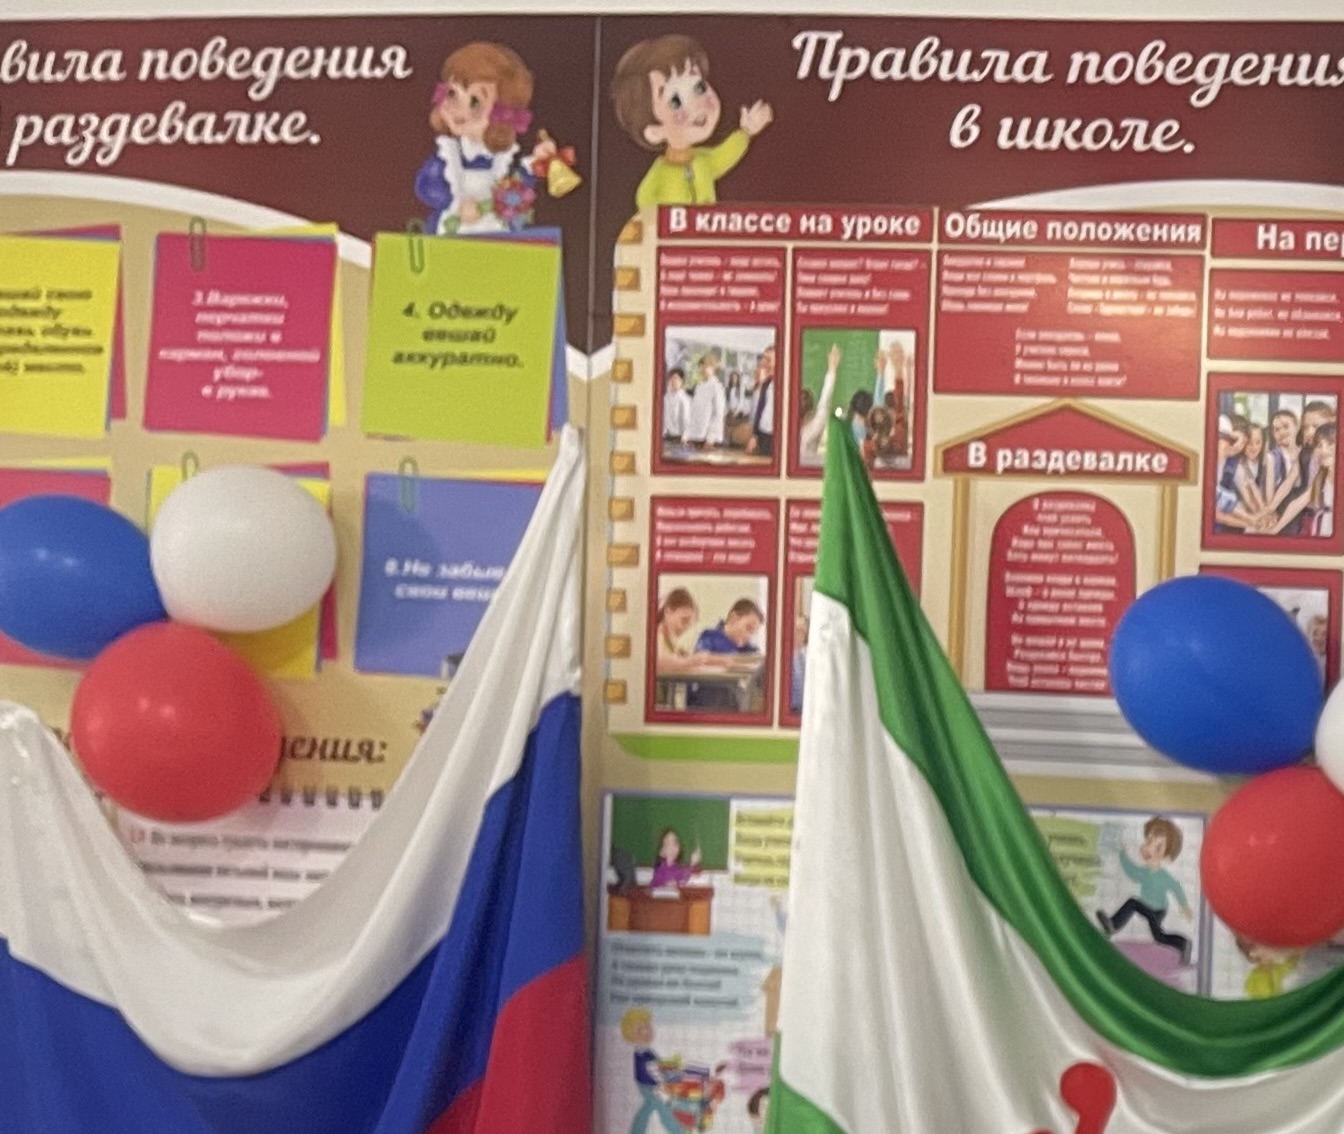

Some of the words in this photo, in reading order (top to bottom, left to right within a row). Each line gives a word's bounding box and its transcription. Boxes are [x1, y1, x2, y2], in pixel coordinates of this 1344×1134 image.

[0, 39, 127, 83] вила
[138, 35, 412, 101] поведения
[792, 30, 1053, 102] Правила
[6, 101, 321, 166] раздевалке.
[949, 103, 982, 149] в
[996, 113, 1195, 153] школе.
[669, 207, 688, 233] В
[695, 211, 792, 234] классе
[799, 213, 833, 235] на
[841, 214, 921, 240] уроке
[945, 212, 1038, 243] Общие
[1046, 221, 1201, 242] положения
[1257, 224, 1295, 251] На
[428, 300, 518, 325] Одежду
[968, 441, 987, 468] В
[995, 447, 1168, 475] раздевалке
[281, 736, 387, 763] ения:
